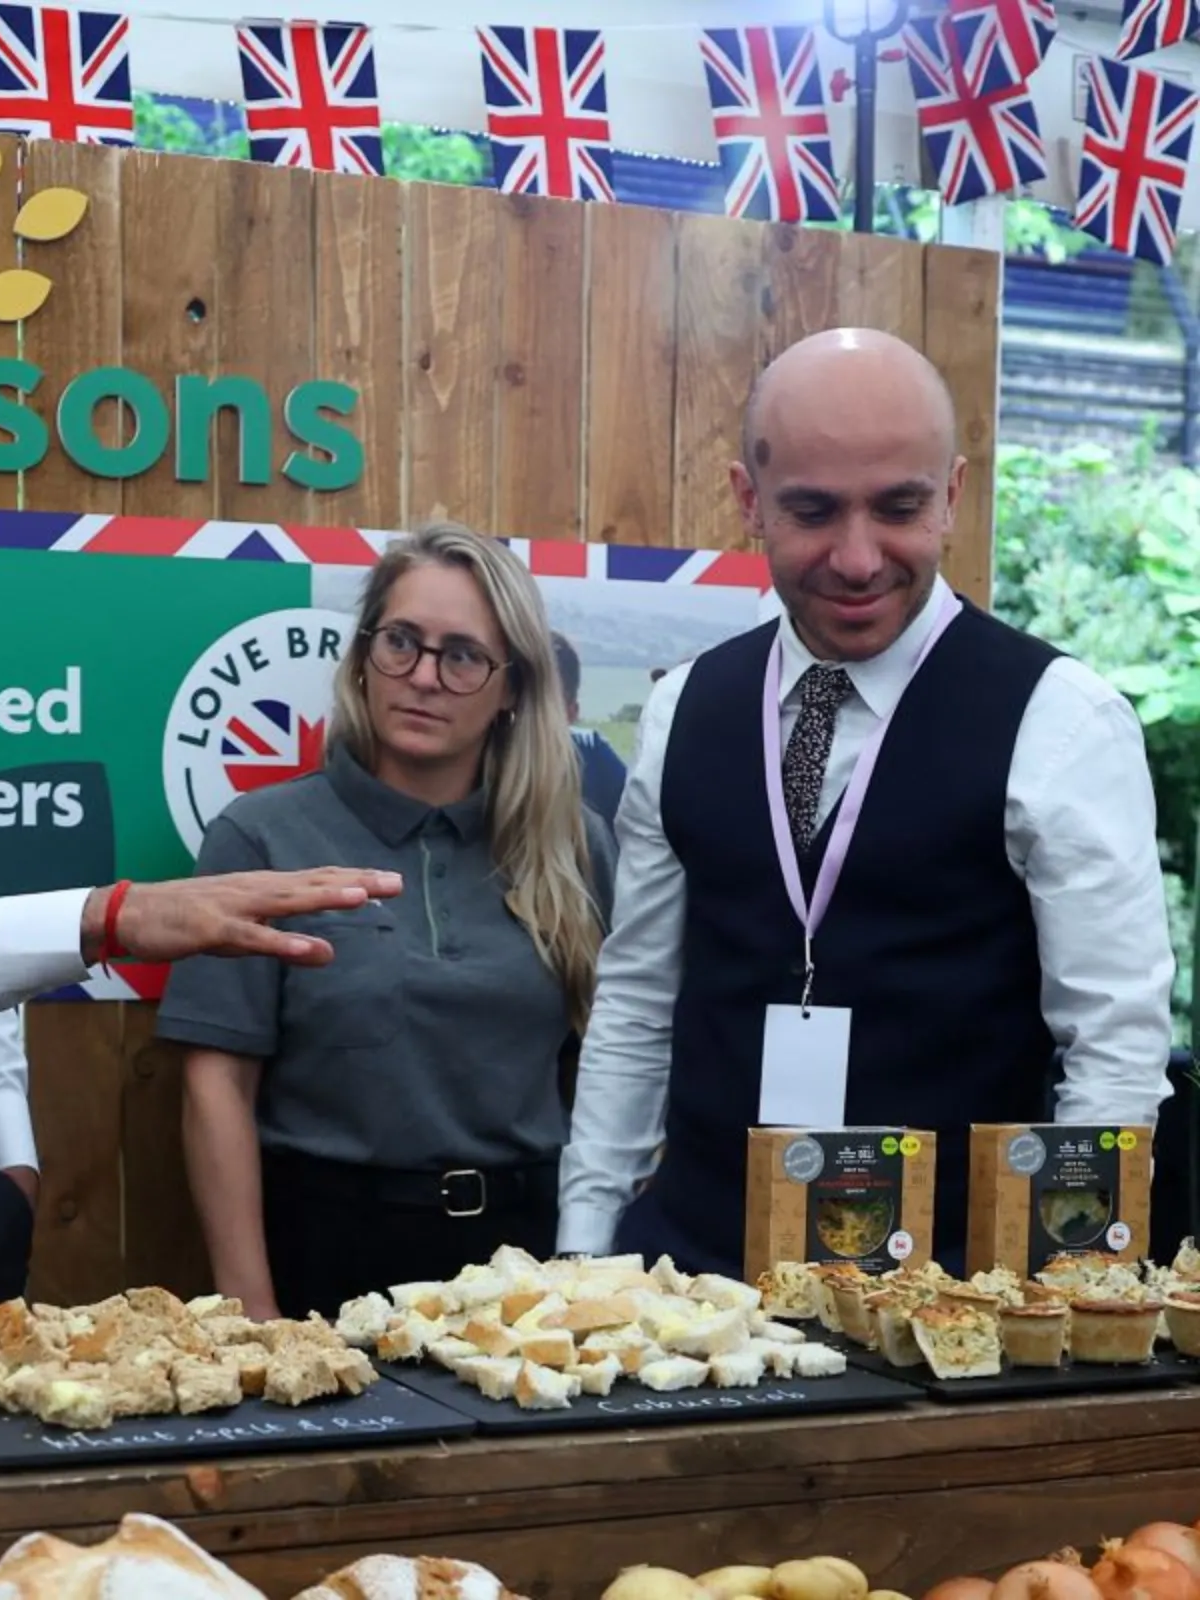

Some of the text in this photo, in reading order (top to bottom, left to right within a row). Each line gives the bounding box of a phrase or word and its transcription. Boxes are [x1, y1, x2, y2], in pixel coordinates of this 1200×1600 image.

[177, 627, 341, 748] LOVE BR
[597, 1388, 806, 1413] Coburg cob
